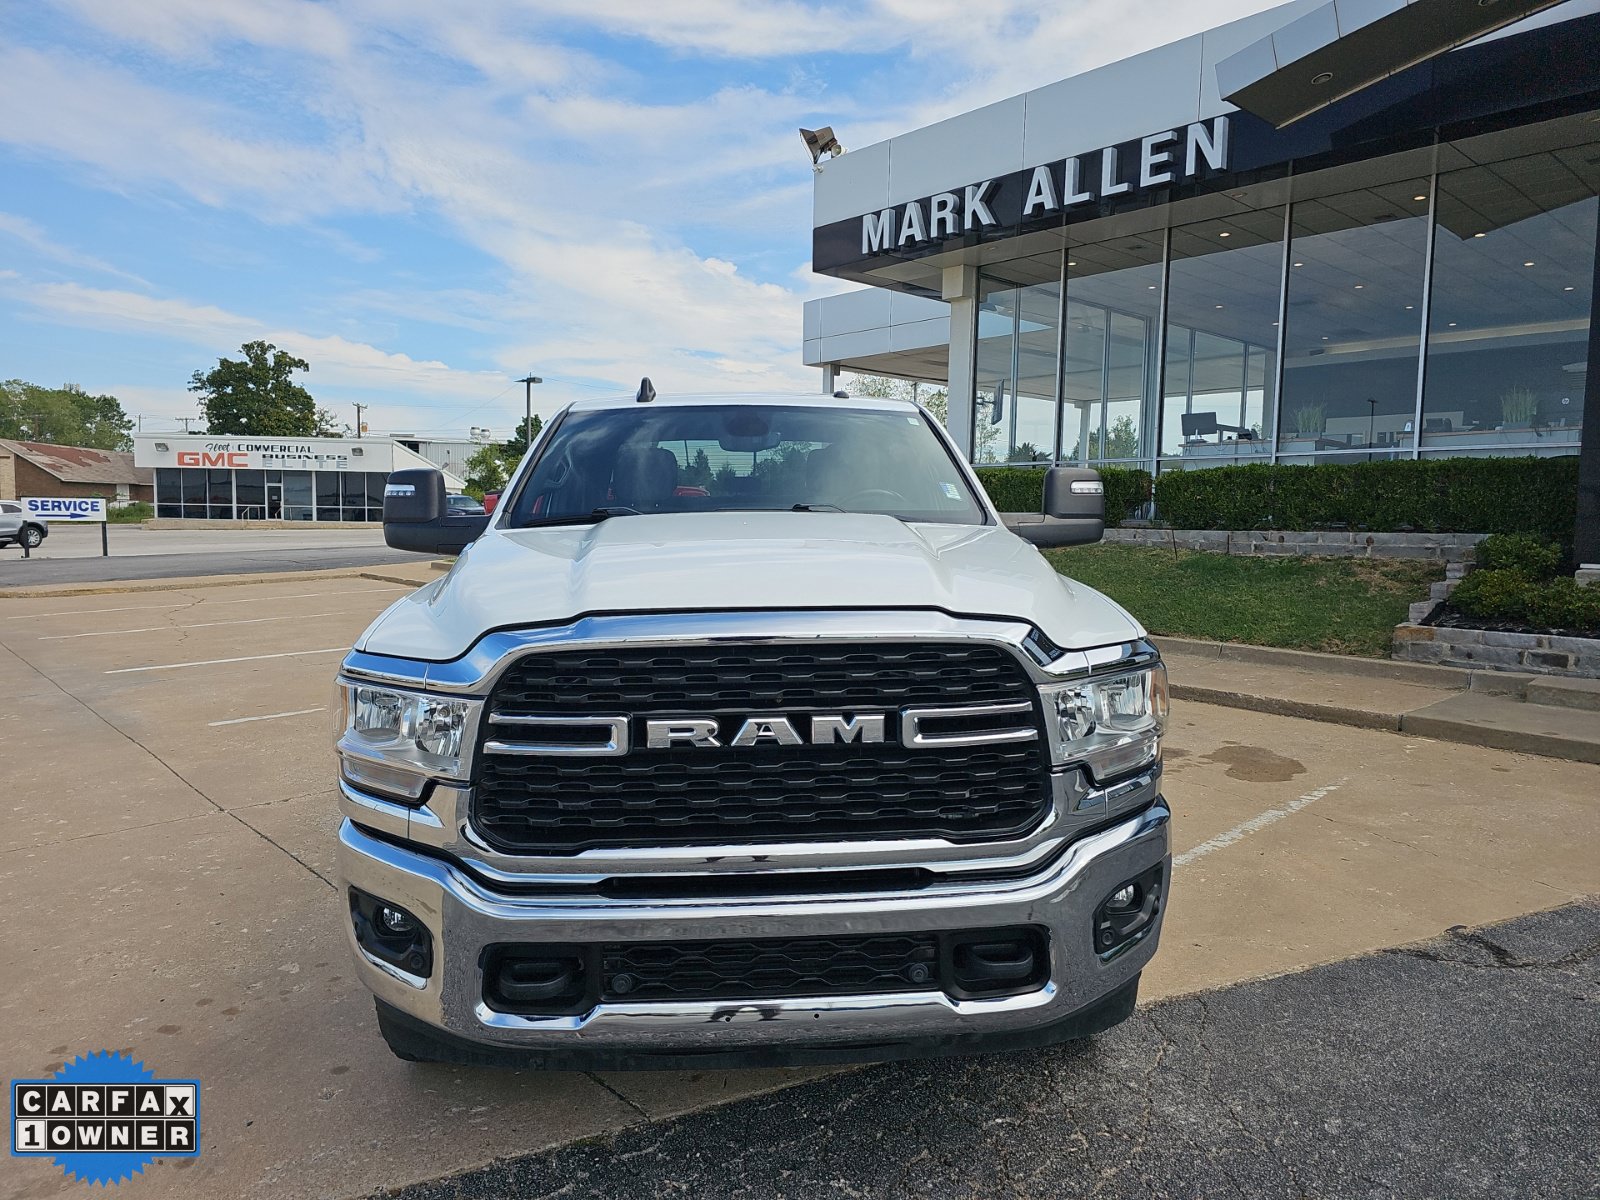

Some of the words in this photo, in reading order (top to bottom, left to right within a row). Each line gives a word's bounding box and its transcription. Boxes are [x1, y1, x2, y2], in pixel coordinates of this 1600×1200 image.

[861, 180, 996, 256] MARK
[1023, 116, 1230, 216] ALLEN
[205, 442, 231, 453] Fleet
[237, 443, 315, 454] COMMERCIAL
[177, 452, 249, 468] GMC
[262, 460, 348, 469] ELITE
[27, 499, 100, 512] SERVICE
[646, 714, 886, 748] RAM
